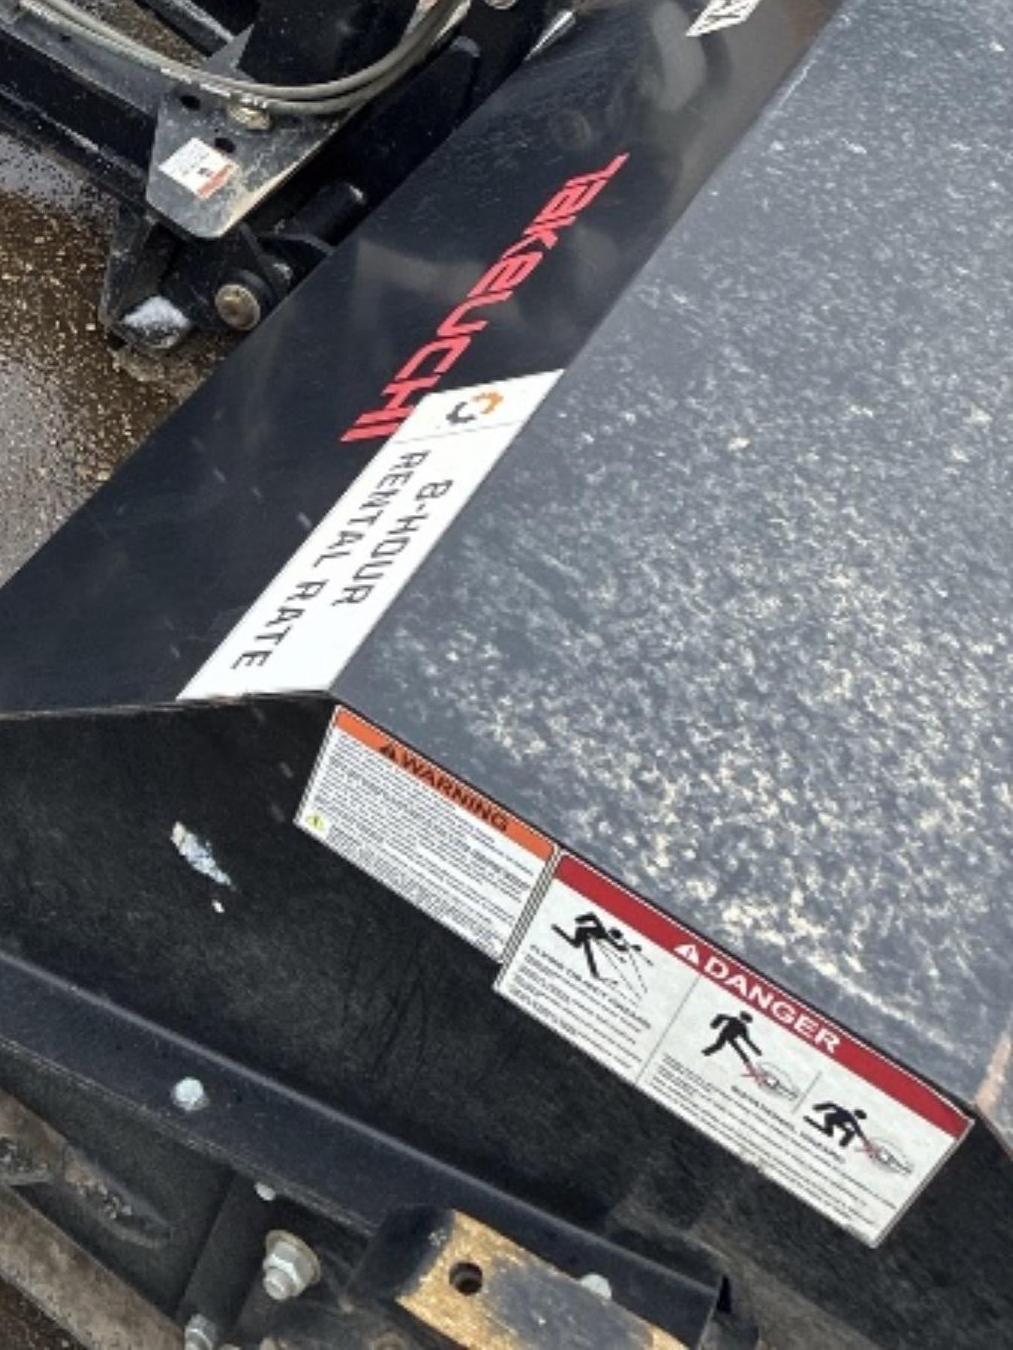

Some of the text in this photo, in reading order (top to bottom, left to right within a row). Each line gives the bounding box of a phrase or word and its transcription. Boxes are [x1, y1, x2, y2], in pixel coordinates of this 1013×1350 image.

[229, 450, 432, 670] RENTAL RATE
[330, 479, 454, 607] 8-HOUR
[400, 747, 507, 832] WARNING
[703, 956, 841, 1054] DANGER
